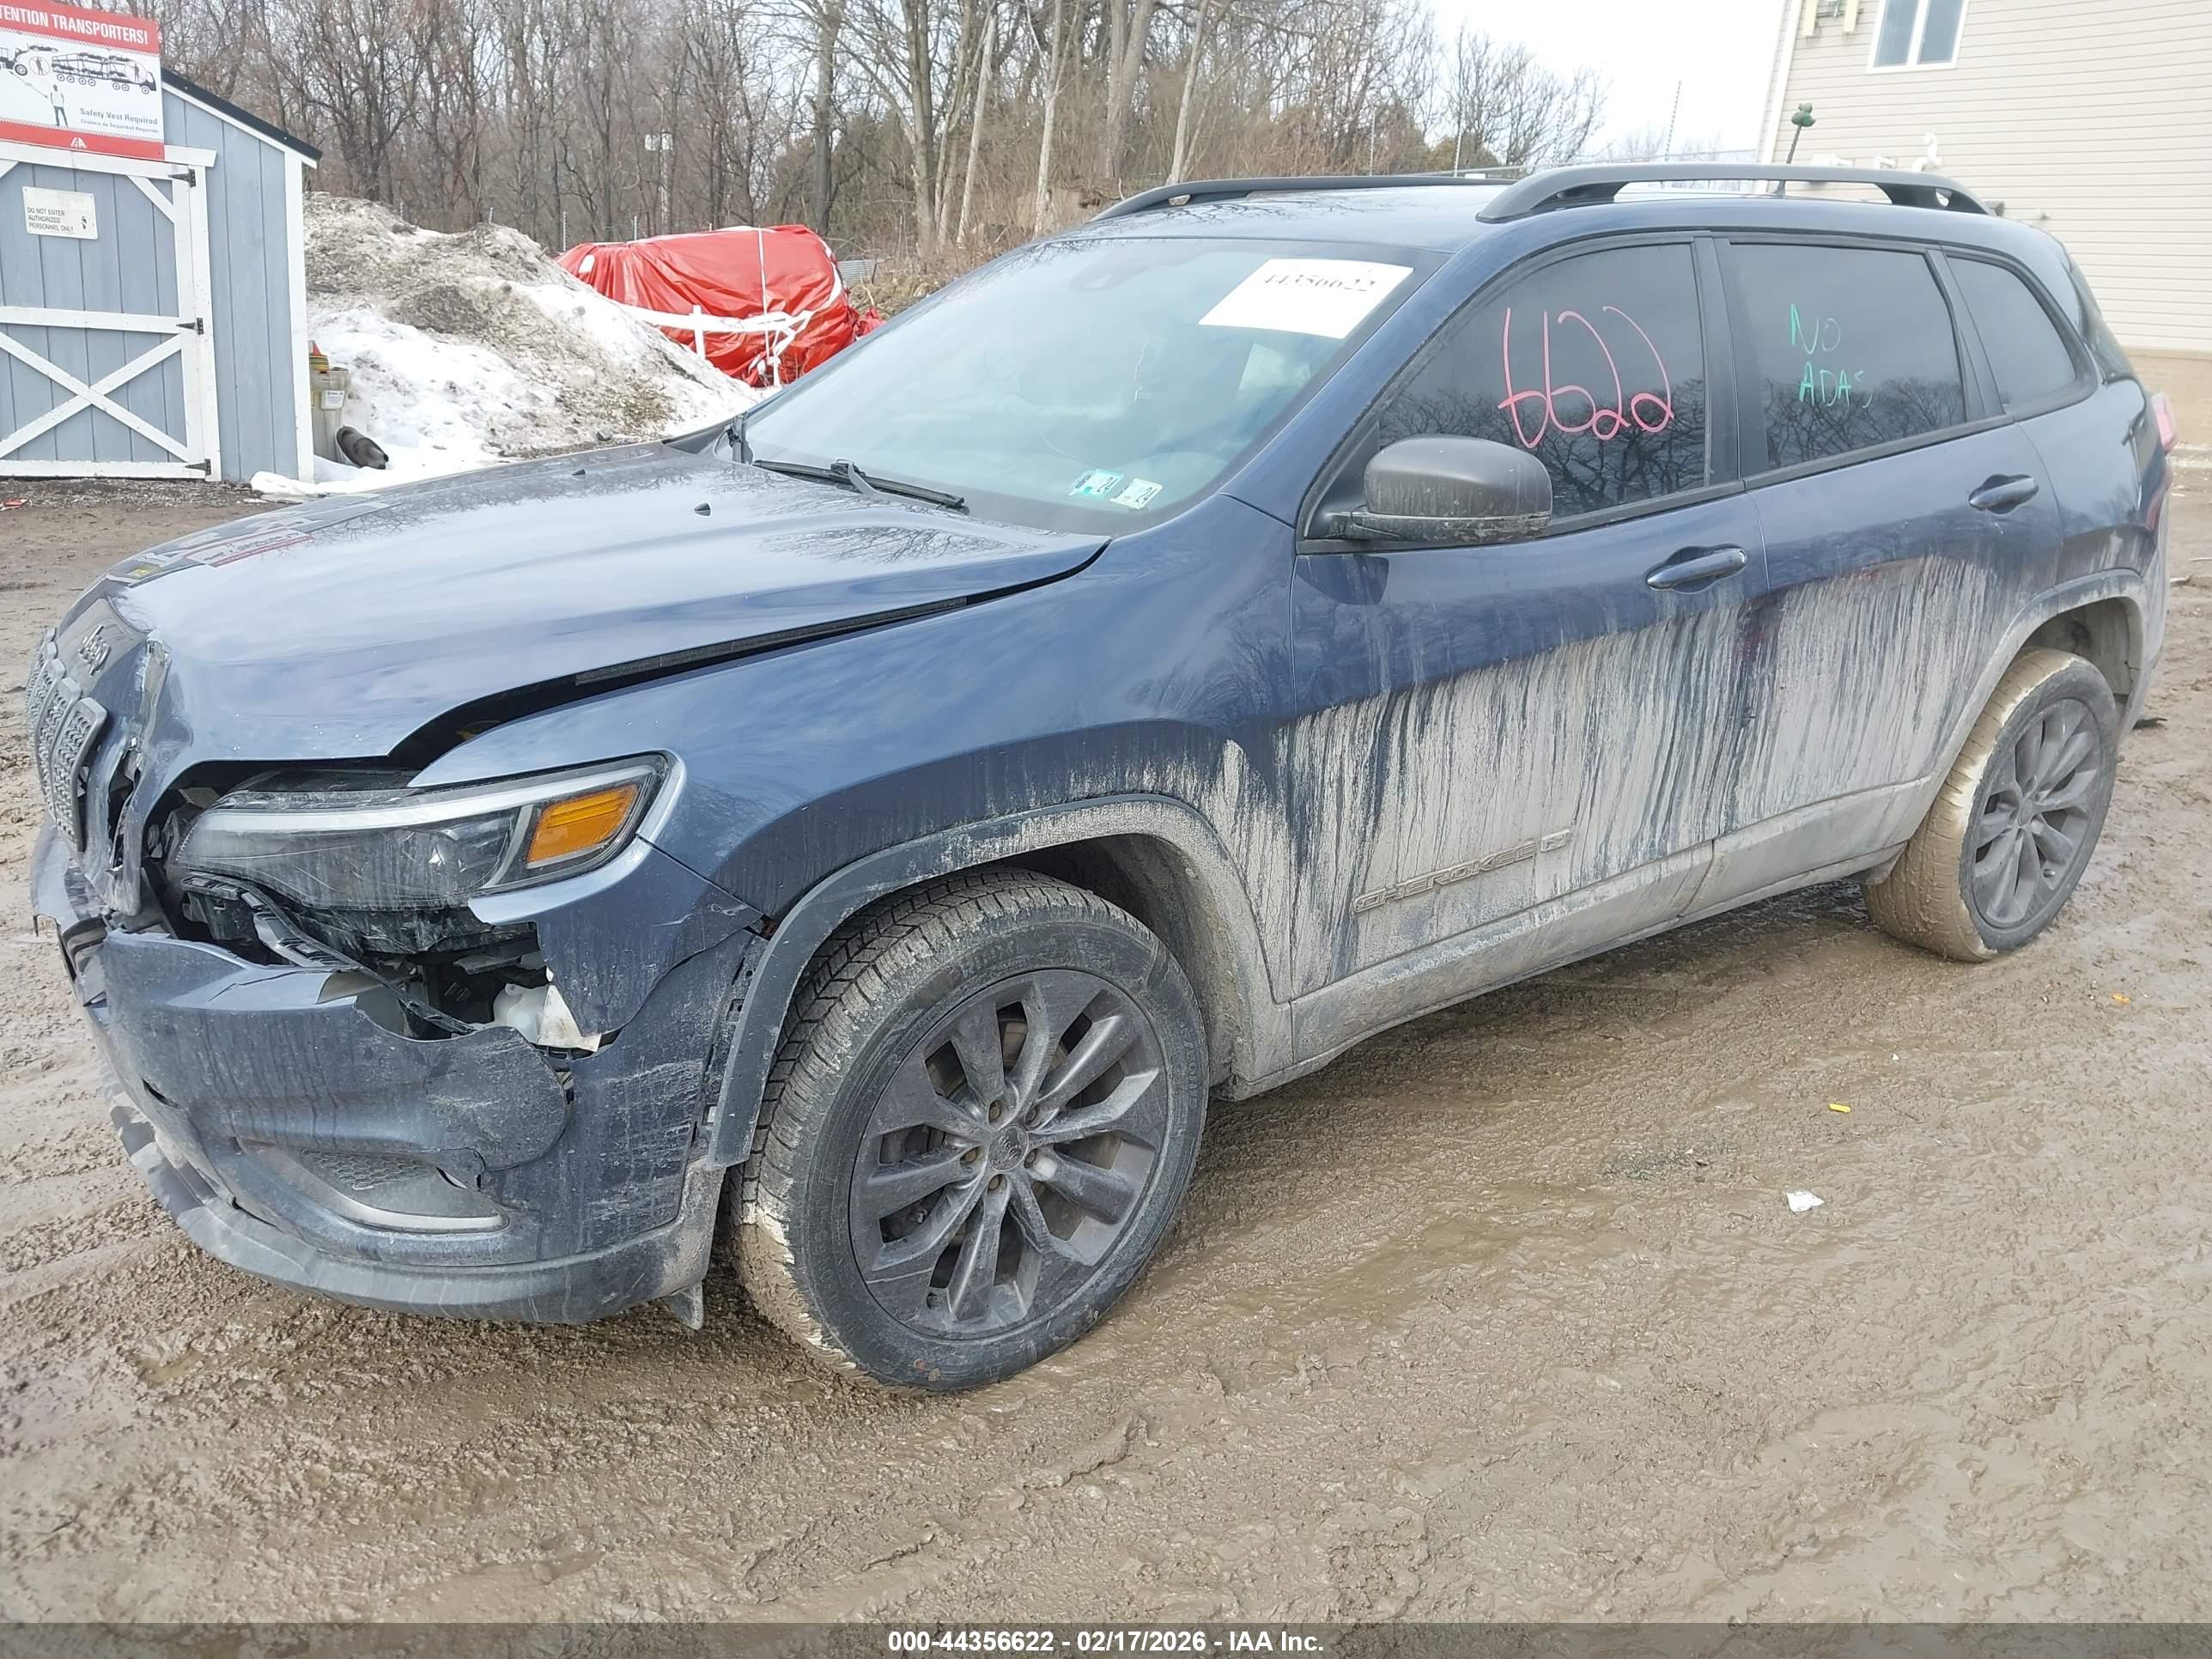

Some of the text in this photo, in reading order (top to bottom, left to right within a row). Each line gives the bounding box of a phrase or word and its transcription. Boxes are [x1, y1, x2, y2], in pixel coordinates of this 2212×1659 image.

[52, 14, 149, 45] TRANSPORTERS!
[80, 107, 158, 125] Safety Vest Required
[28, 215, 61, 223] AUTHORIZED
[28, 222, 60, 231] PERSONNEL
[1790, 302, 1841, 355] NO
